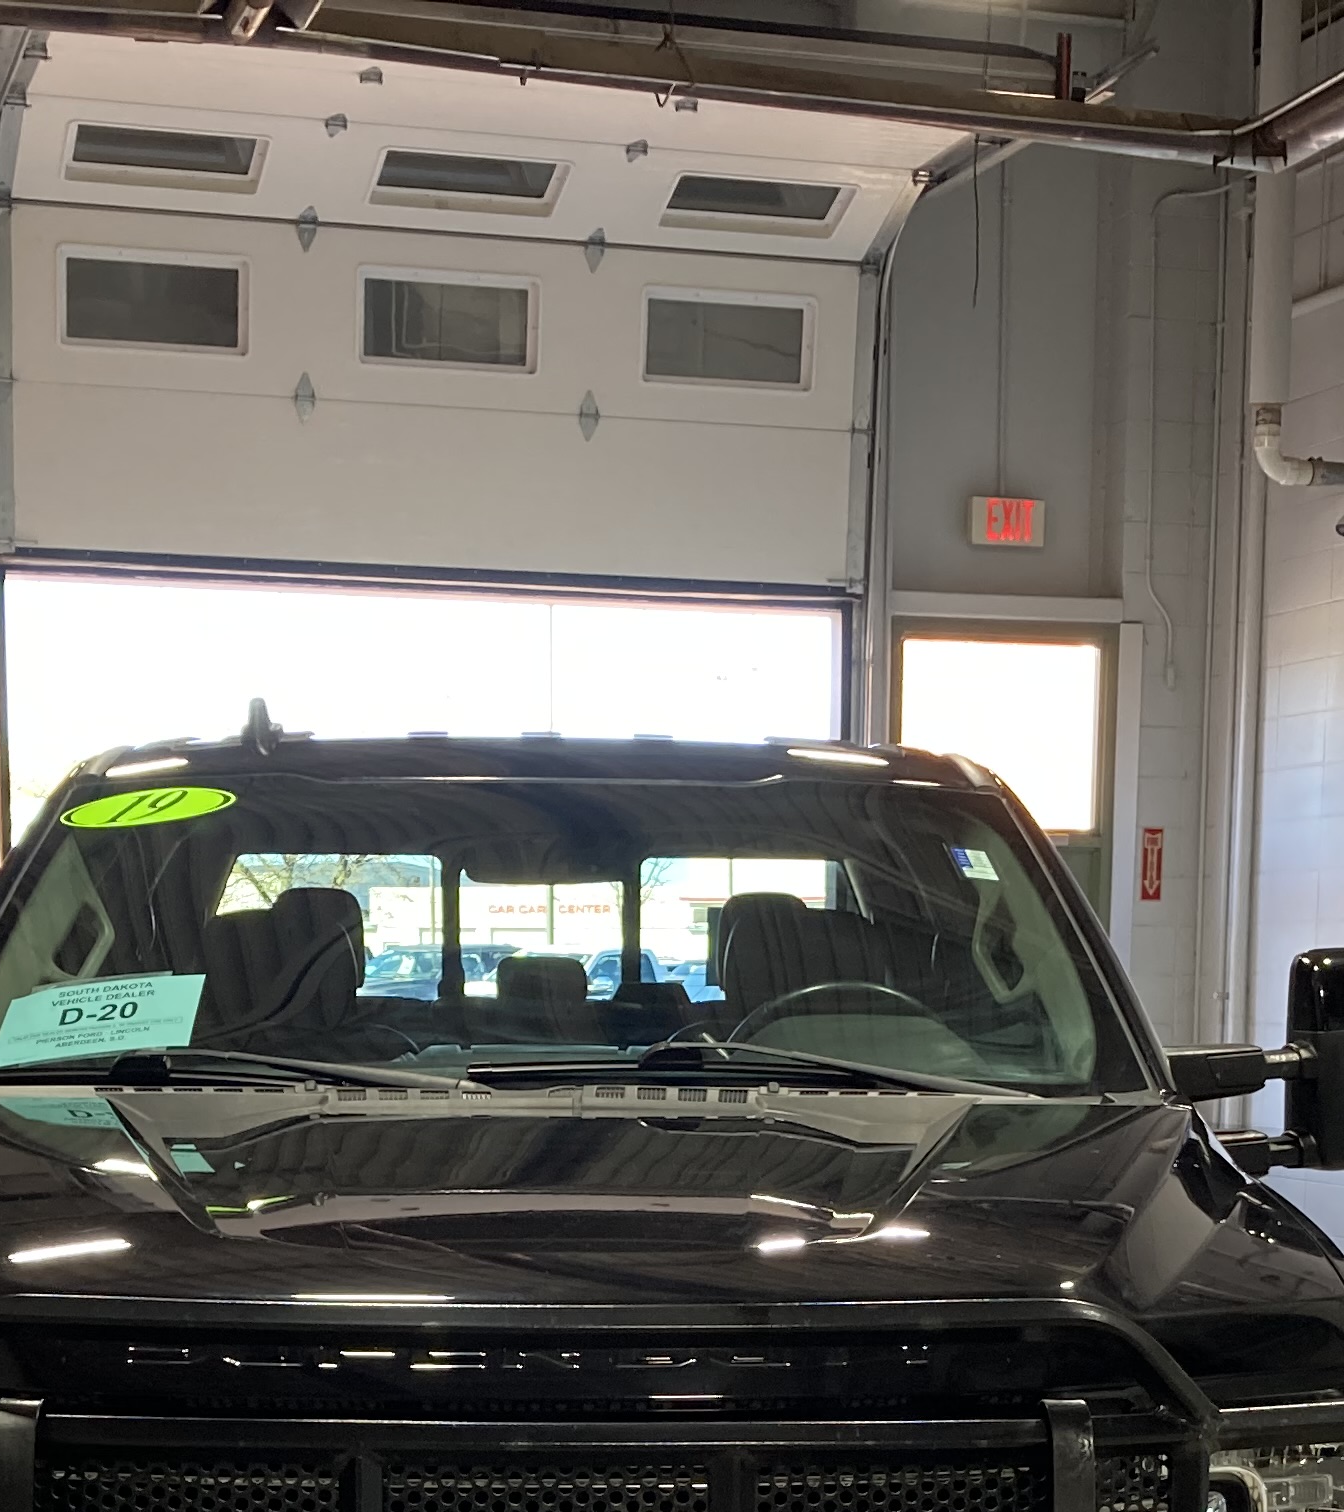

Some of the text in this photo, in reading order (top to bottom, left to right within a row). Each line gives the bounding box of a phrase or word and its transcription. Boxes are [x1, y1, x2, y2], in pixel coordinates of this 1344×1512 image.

[986, 497, 1034, 542] EXIT
[99, 790, 188, 823] 19
[488, 905, 611, 914] CAR CAR CENTER
[51, 989, 155, 1007] VEHICLE DEALER
[58, 981, 153, 998] SOUTH DAKOTA
[58, 1001, 138, 1026] D-20
